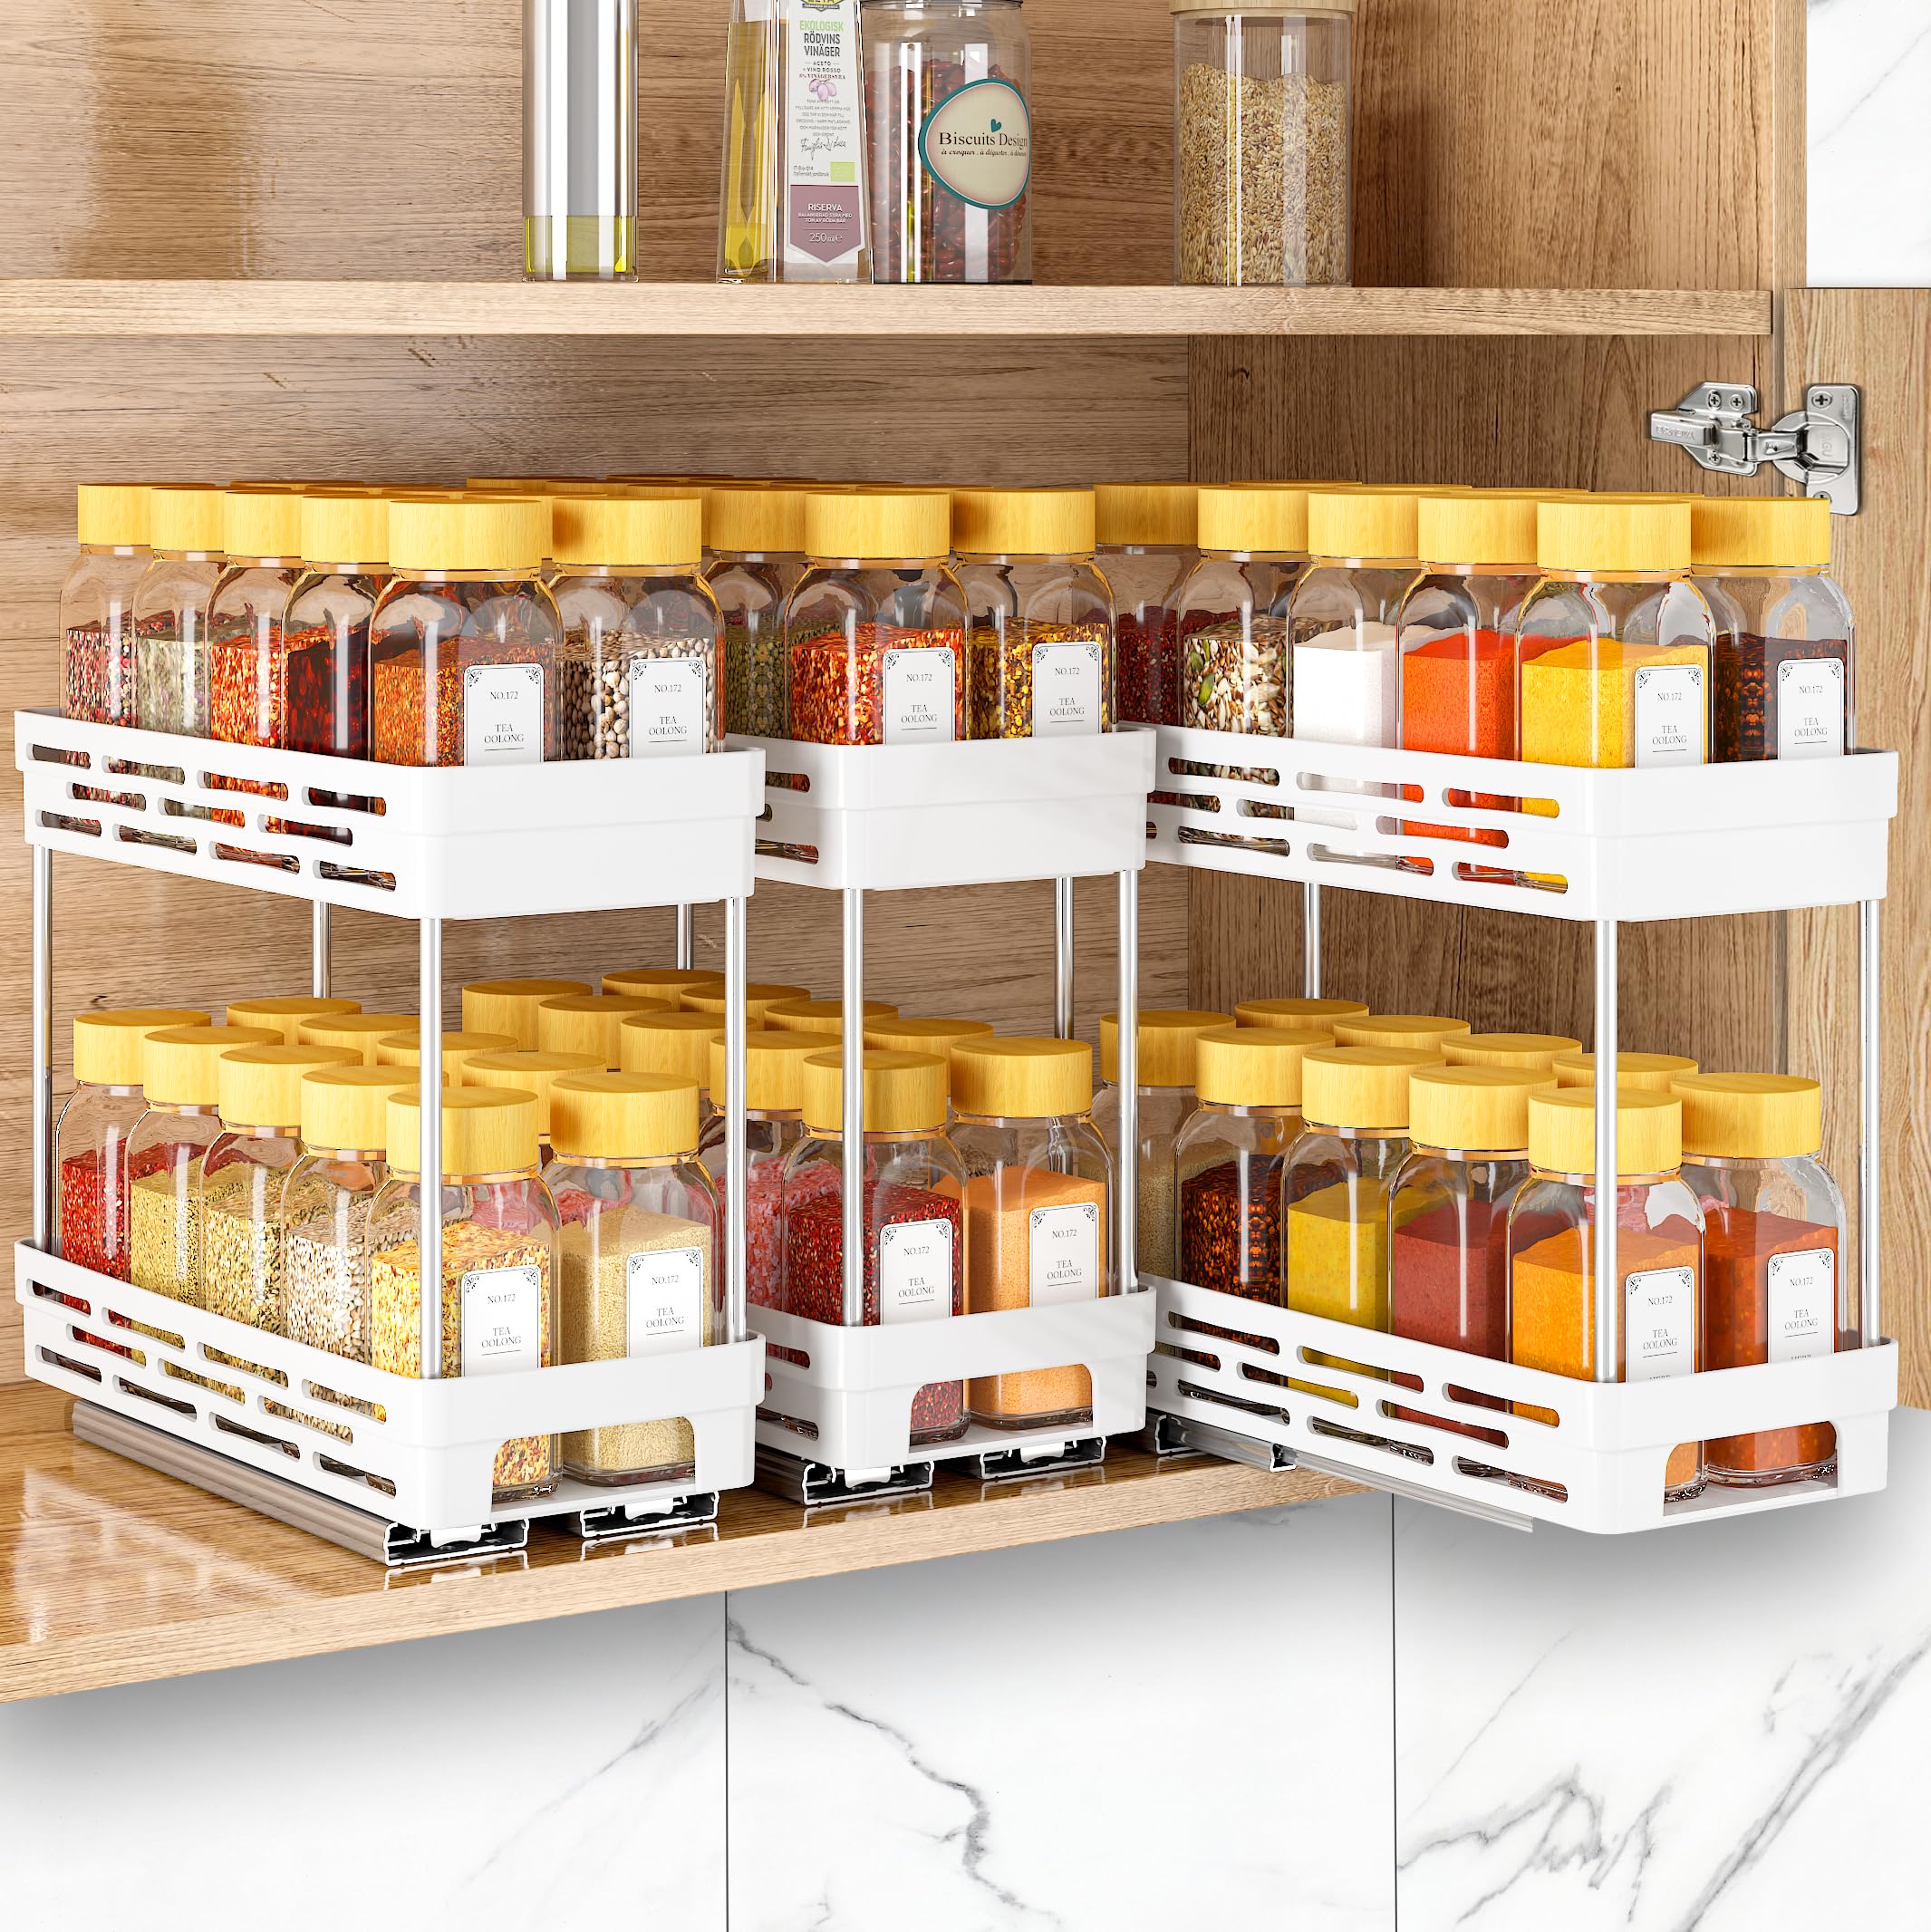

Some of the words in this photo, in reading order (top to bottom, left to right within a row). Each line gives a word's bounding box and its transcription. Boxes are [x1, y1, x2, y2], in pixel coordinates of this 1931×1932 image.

[799, 20, 844, 32] EKOLOGISK
[804, 30, 841, 44] RÖDVINS
[804, 43, 840, 57] VINÄGER
[939, 131, 996, 145] Biscuits
[999, 132, 1028, 150] Design
[807, 203, 843, 212] RISERVA
[1055, 667, 1080, 676] NO.172
[906, 673, 932, 682] NO.172
[654, 684, 681, 692] NO.172
[1799, 685, 1823, 694] NO.172
[489, 691, 518, 700] NO.172
[1657, 692, 1682, 701] NO.172
[1058, 697, 1076, 706] TEA
[911, 704, 928, 713] TEA
[1049, 707, 1085, 717] OOLONG
[660, 716, 677, 725] TEA
[901, 714, 937, 724] OOLONG
[1803, 717, 1819, 726] TEA
[495, 723, 514, 732] TEA
[649, 726, 687, 736] OOLONG
[1661, 725, 1677, 734] TEA
[1794, 727, 1828, 737] OOLONG
[484, 733, 524, 744] OOLONG
[1652, 735, 1687, 745] OOLONG
[1052, 1229, 1077, 1239] NO.172
[903, 1246, 930, 1256] NO.172
[1057, 1260, 1073, 1269] TEA
[1047, 1268, 1082, 1280] OOLONG
[652, 1274, 680, 1285] NO.172
[908, 1277, 925, 1287] TEA
[1790, 1276, 1813, 1287] NO.172
[898, 1286, 935, 1298] OOLONG
[488, 1293, 516, 1304] NO.172
[1647, 1295, 1673, 1306] NO.172
[656, 1307, 674, 1317] TEA
[1793, 1309, 1810, 1319] TEA
[646, 1316, 685, 1328] OOLONG
[1784, 1318, 1819, 1330] OOLONG
[493, 1327, 511, 1337] TEA
[1652, 1328, 1668, 1338] TEA
[481, 1336, 522, 1348] OOLONG
[1643, 1338, 1678, 1350] OOLONG
